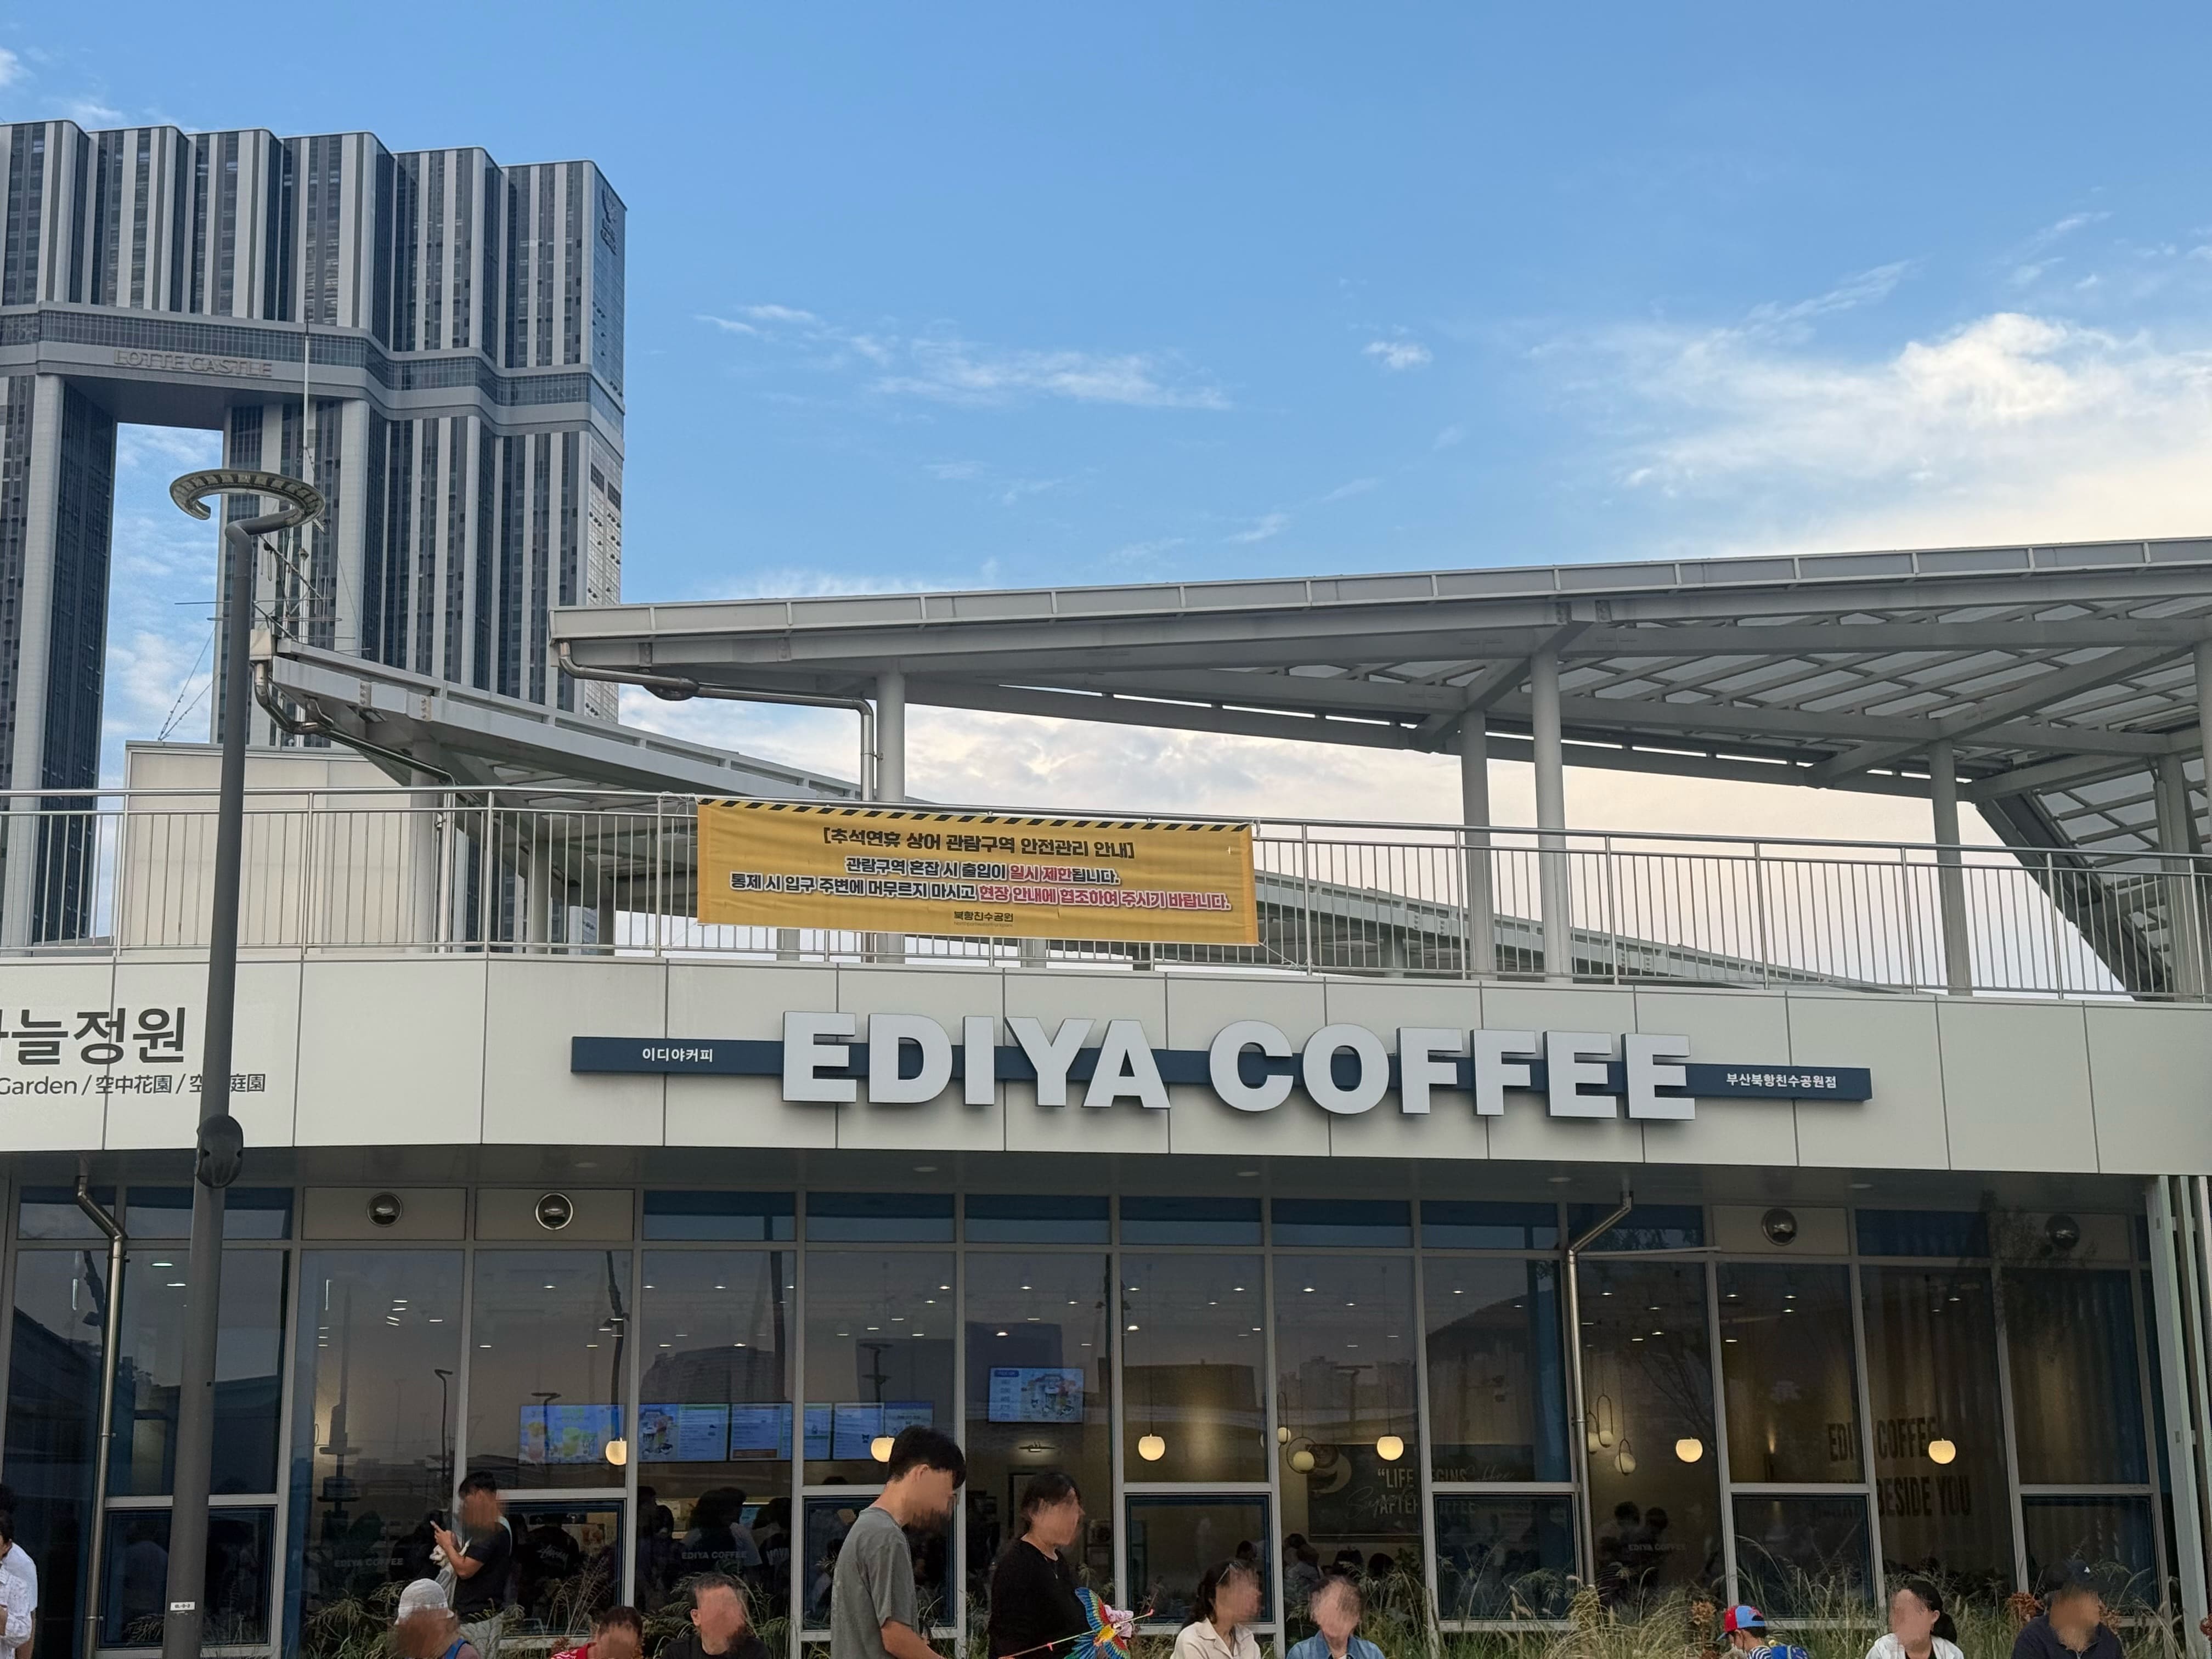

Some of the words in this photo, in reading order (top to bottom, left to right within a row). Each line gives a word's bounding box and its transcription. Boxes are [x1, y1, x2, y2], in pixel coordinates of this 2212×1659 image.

[114, 349, 185, 370] LOTTE
[189, 357, 273, 377] CASTLE
[906, 832, 941, 850] 상어
[946, 834, 1015, 854] 관람구역
[1021, 838, 1088, 856] 안전관리
[846, 857, 905, 874] 관람구역
[910, 860, 939, 876] 혼잡
[944, 862, 958, 877] 시
[962, 863, 1006, 879] 출입이
[1010, 865, 1040, 881] 일시
[1042, 866, 1119, 883] 제한됩니다.
[731, 873, 761, 890] 통제
[765, 875, 780, 890] 시
[785, 876, 815, 891] 입구
[819, 878, 864, 894] 주변에
[868, 880, 927, 897] 머무르지
[932, 883, 975, 899] 마시고
[979, 885, 1009, 901] 현장
[1013, 887, 1056, 903] 안내에
[1060, 888, 1118, 905] 협조하여
[1122, 891, 1164, 907] 주시기
[1169, 893, 1231, 909] 바랍니다.
[953, 911, 1014, 922] 북항친수공원
[0, 1007, 185, 1065] 늘정원
[642, 1048, 713, 1062] 이디야커피
[782, 1011, 1171, 1109] EDIYA
[1209, 1020, 1696, 1120] COFFEE
[95, 1075, 172, 1094] 空中花園
[189, 1074, 266, 1093] 空庭園
[1726, 1073, 1837, 1088] 부산북항친수공원점
[1827, 1423, 1854, 1462] EDI
[1936, 1475, 1971, 1516] YOU
[712, 1550, 747, 1559] COFFEE
